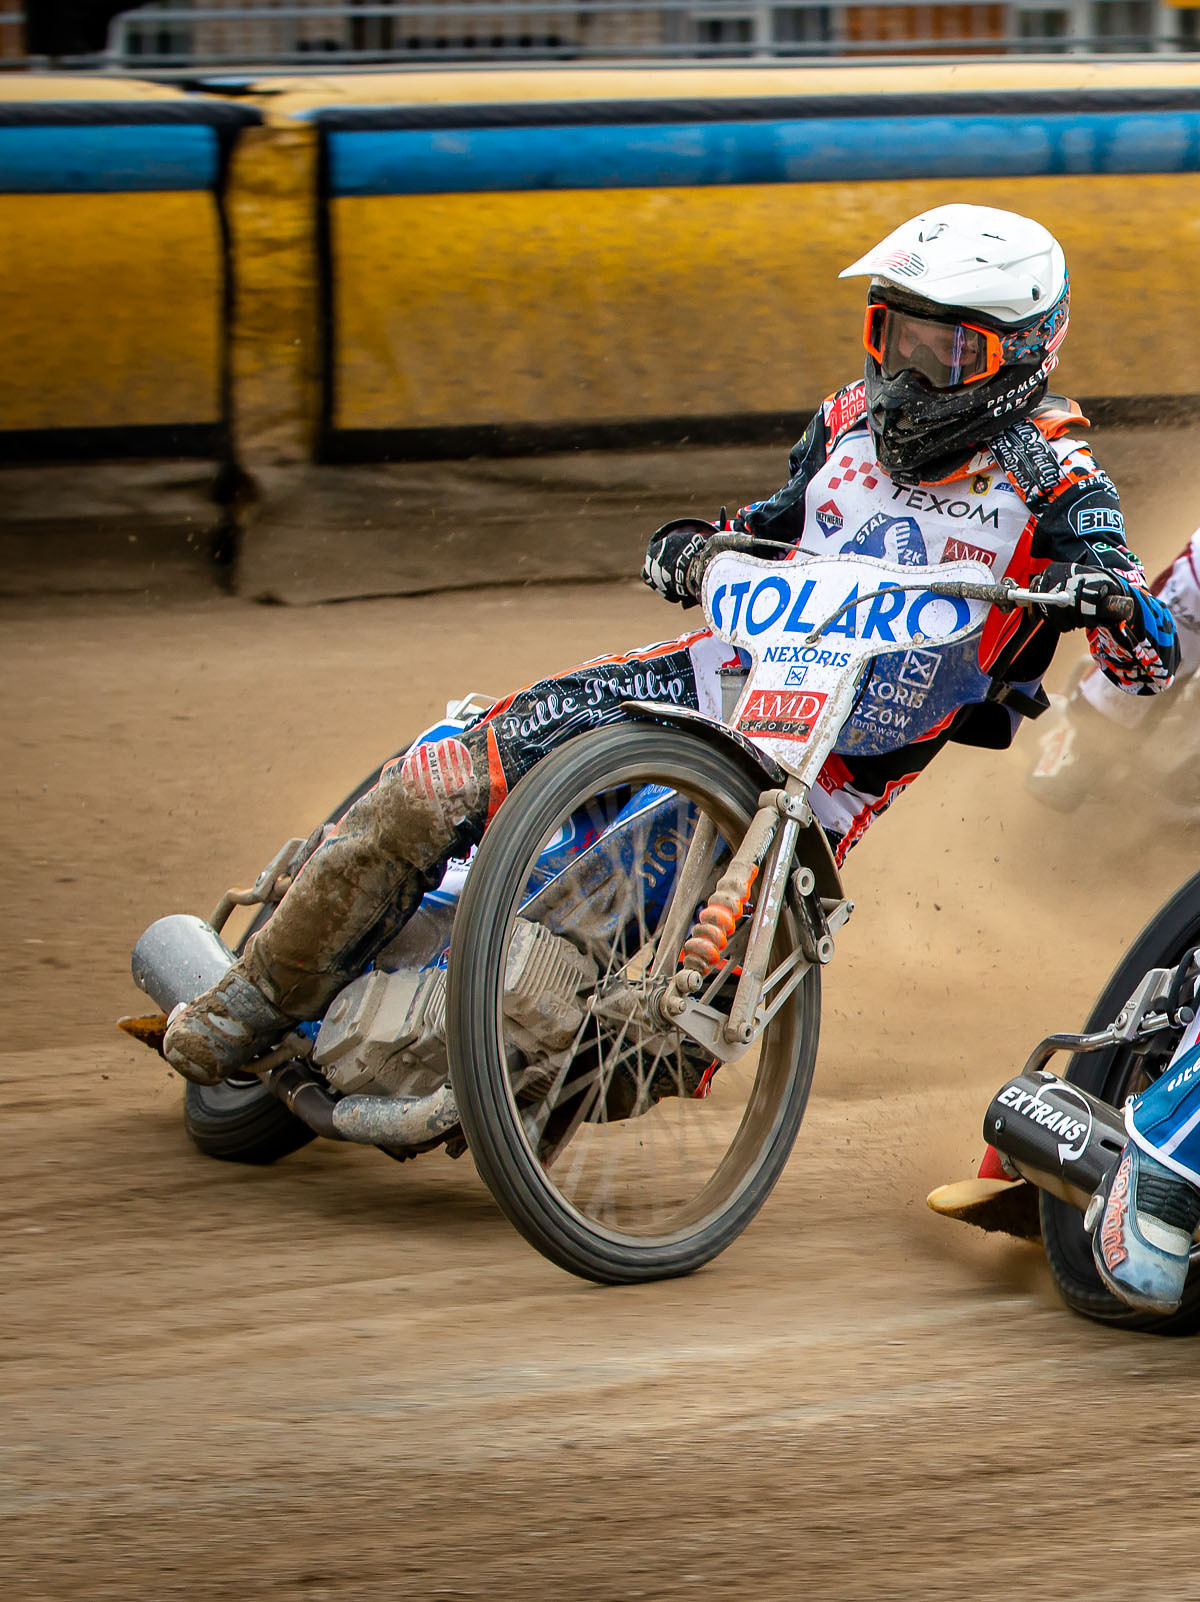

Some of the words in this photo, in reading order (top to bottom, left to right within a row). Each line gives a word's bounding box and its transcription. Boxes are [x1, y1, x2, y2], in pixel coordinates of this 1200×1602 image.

[892, 482, 999, 529] TEXOM
[855, 514, 888, 545] STAL
[675, 533, 707, 597] ASTRA
[949, 539, 993, 570] AMD
[711, 575, 971, 643] STOLARO
[762, 646, 851, 668] NEXORIS
[501, 694, 580, 740] Palle
[584, 670, 685, 706] Phillip
[743, 695, 821, 720] AMD
[867, 679, 925, 709] XORIS
[996, 1085, 1088, 1142] EXTRANS
